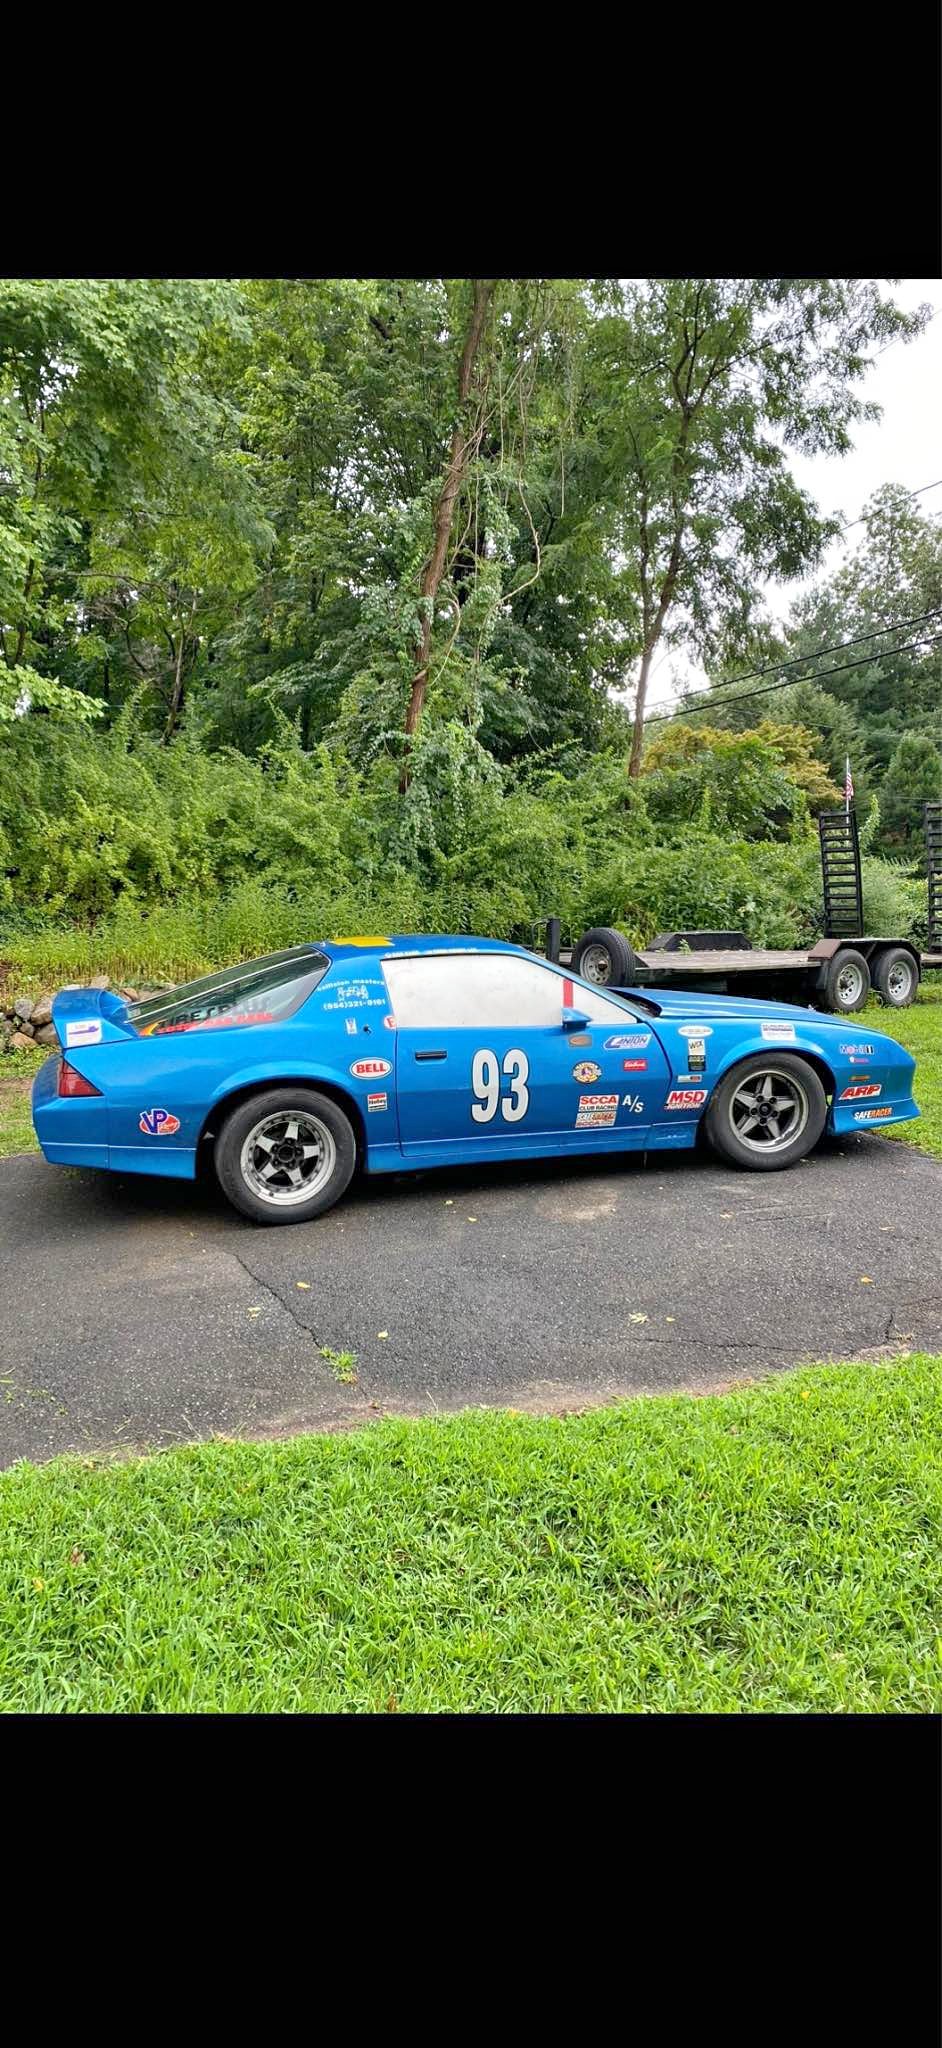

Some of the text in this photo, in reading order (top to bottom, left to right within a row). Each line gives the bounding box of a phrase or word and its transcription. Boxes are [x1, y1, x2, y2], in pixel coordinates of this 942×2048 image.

[356, 1063, 387, 1074] BELL
[471, 1048, 529, 1123] 93
[841, 1085, 881, 1099] ARP
[580, 1096, 617, 1105] SCCA
[622, 1094, 644, 1113] A/S
[669, 1091, 705, 1104] MSD
[140, 1109, 169, 1134] VP
